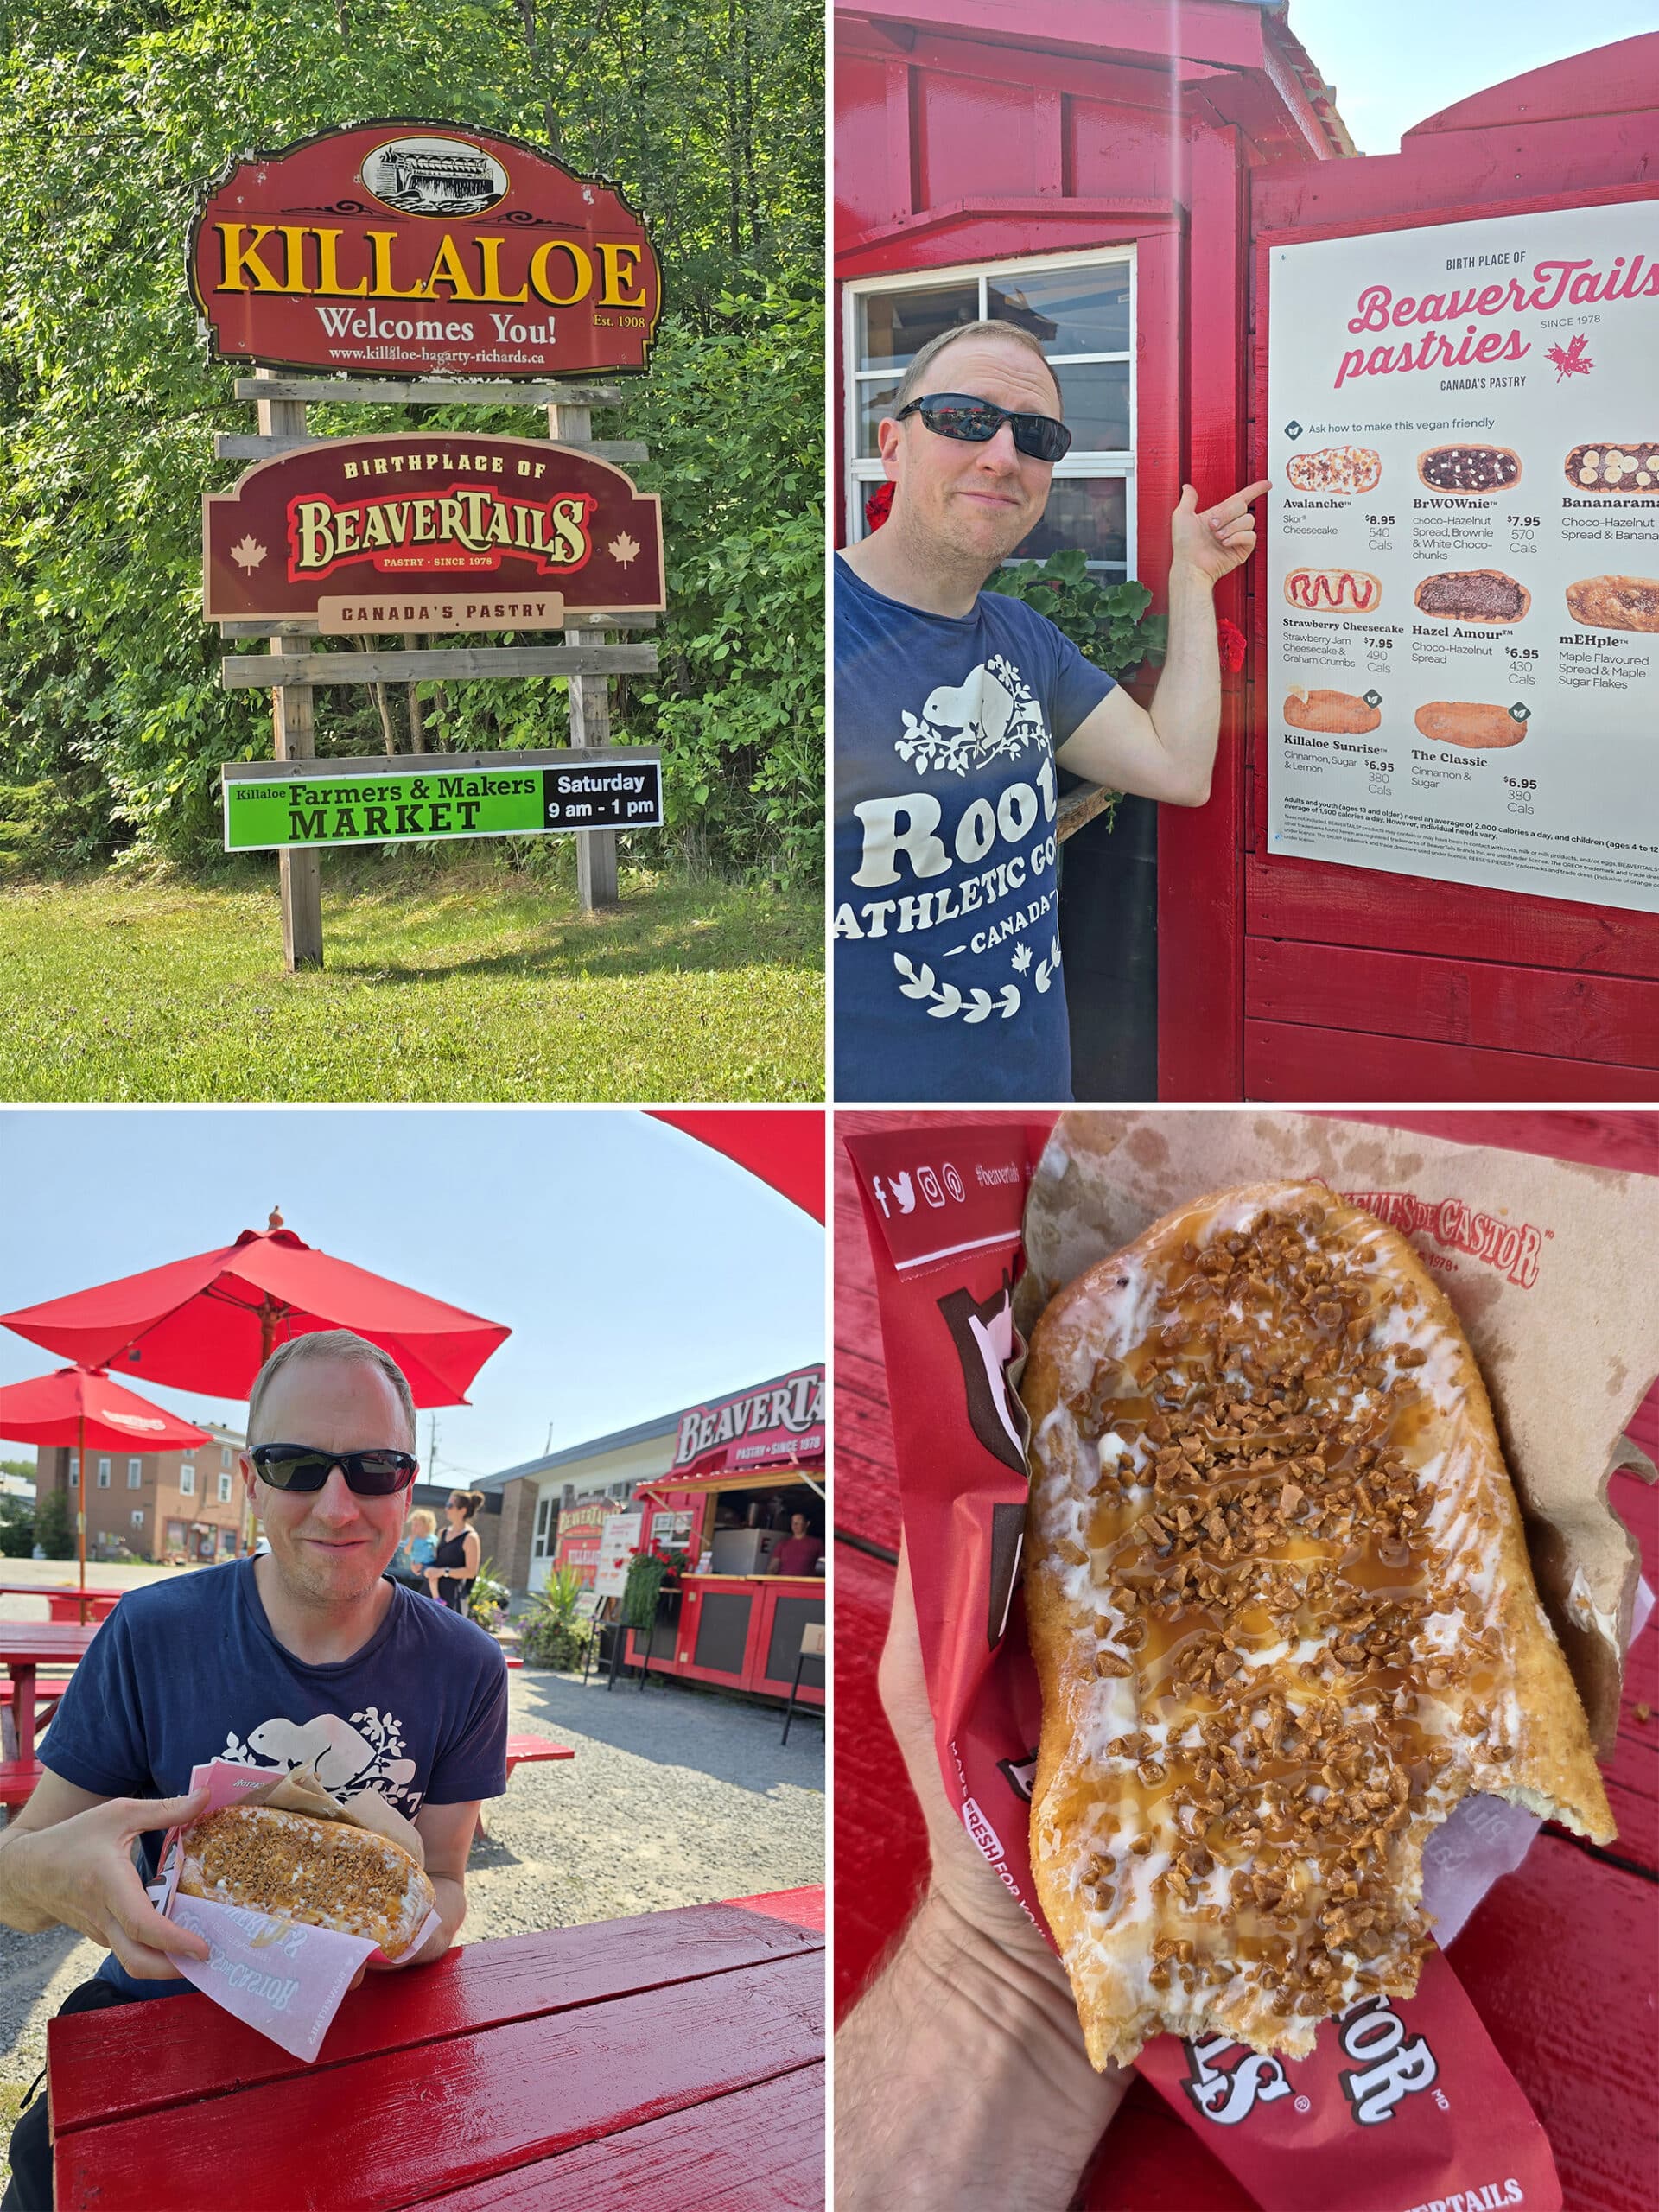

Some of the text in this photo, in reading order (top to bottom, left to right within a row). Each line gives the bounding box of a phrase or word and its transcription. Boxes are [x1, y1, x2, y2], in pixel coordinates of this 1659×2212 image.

[215, 222, 646, 307] KILLALOE
[1446, 251, 1525, 270] BIRTH PLACE OF
[1348, 255, 1659, 334] BeaverTails
[316, 307, 556, 344] Welcomes You!
[594, 314, 645, 328] Est. 1908
[1541, 315, 1600, 328] SINCE 1978
[329, 346, 544, 364] www.killaloe-hagarty-richards.ca
[1334, 325, 1531, 388] pastries
[1440, 376, 1526, 391] CANADA'S PASTRY
[1309, 417, 1495, 433] Ask how to make this vegan friendly
[345, 454, 546, 479] BIRTHPLACE OF
[1562, 498, 1659, 508] Bananaram
[1365, 515, 1395, 526] $8.95
[1413, 517, 1491, 526] Choco-Hazelnut
[1507, 516, 1541, 527] $7.95
[1562, 518, 1655, 528] Choco-Hazelnut
[1283, 526, 1338, 535] Cheesecake
[1369, 528, 1389, 537] 540
[1413, 528, 1493, 538] Spread, Brownie
[1511, 530, 1534, 540] 570
[1562, 530, 1659, 541] Spread & Banana
[1369, 540, 1392, 550] Cals
[1413, 539, 1492, 550] & White Choco-
[1510, 543, 1537, 554] Cals
[1413, 550, 1447, 560] chunks
[384, 558, 424, 567] PASTRY
[434, 557, 465, 566] SINCE
[342, 603, 546, 621] CANADA'S PASTRY
[1283, 618, 1404, 634] Strawberry Cheesecake
[1413, 626, 1449, 638] Hazel
[1283, 632, 1351, 645] Strawberry Jam
[1364, 637, 1393, 649] $7.95
[1283, 645, 1336, 655] Cheesecake
[1413, 642, 1492, 656] Choco-Hazelnut
[1505, 647, 1539, 659] $6.95
[1283, 655, 1356, 669] Graham Crumbs
[1367, 651, 1388, 661] 490
[1412, 654, 1446, 665] Spread
[1560, 652, 1649, 665] Maple Flavoured
[1368, 662, 1391, 673] Cals
[1509, 661, 1532, 672] 430
[1559, 664, 1646, 680] Spread & Maple
[1509, 674, 1536, 685] Cals
[1559, 677, 1628, 690] Sugar Flakes
[1284, 734, 1330, 749] Killaloe
[1284, 751, 1357, 767] Cinnamon, Sugar
[1412, 749, 1488, 767] The Classic
[1293, 761, 1323, 773] Lemon
[1364, 760, 1394, 772] $6.95
[1369, 772, 1389, 784] 380
[1412, 766, 1471, 781] Cinnamon &
[558, 774, 645, 796] Saturday
[1412, 777, 1440, 789] Sugar
[1503, 776, 1537, 790] $6.95
[236, 778, 536, 806] Killaloe Farmers & Makers
[1369, 785, 1392, 797] Cals
[1508, 790, 1531, 801] 380
[549, 800, 653, 817] 9 am 1 pm
[1508, 802, 1535, 816] Cals
[289, 802, 480, 840] MARKET
[1284, 804, 1309, 812] average
[1338, 810, 1363, 819] calories
[1371, 815, 1384, 823] day.
[1386, 818, 1418, 828] However,
[1420, 823, 1453, 833] individual
[1479, 831, 1497, 840] vary.
[1319, 801, 1337, 810] youth
[1338, 804, 1357, 812] (ages
[1434, 818, 1463, 828] average
[1498, 826, 1529, 836] calories
[1536, 831, 1553, 840] day,
[1571, 835, 1603, 846] children
[1605, 840, 1629, 850] (ages
[835, 856, 1026, 939] ATHLETIC
[970, 899, 1050, 954] CANADA
[1437, 1198, 1541, 1289] CASTOR
[1429, 1256, 1452, 1271] 1978
[736, 1445, 764, 1459] PASTRY
[771, 1440, 798, 1456] SINCE
[995, 1861, 1020, 1896] FOR
